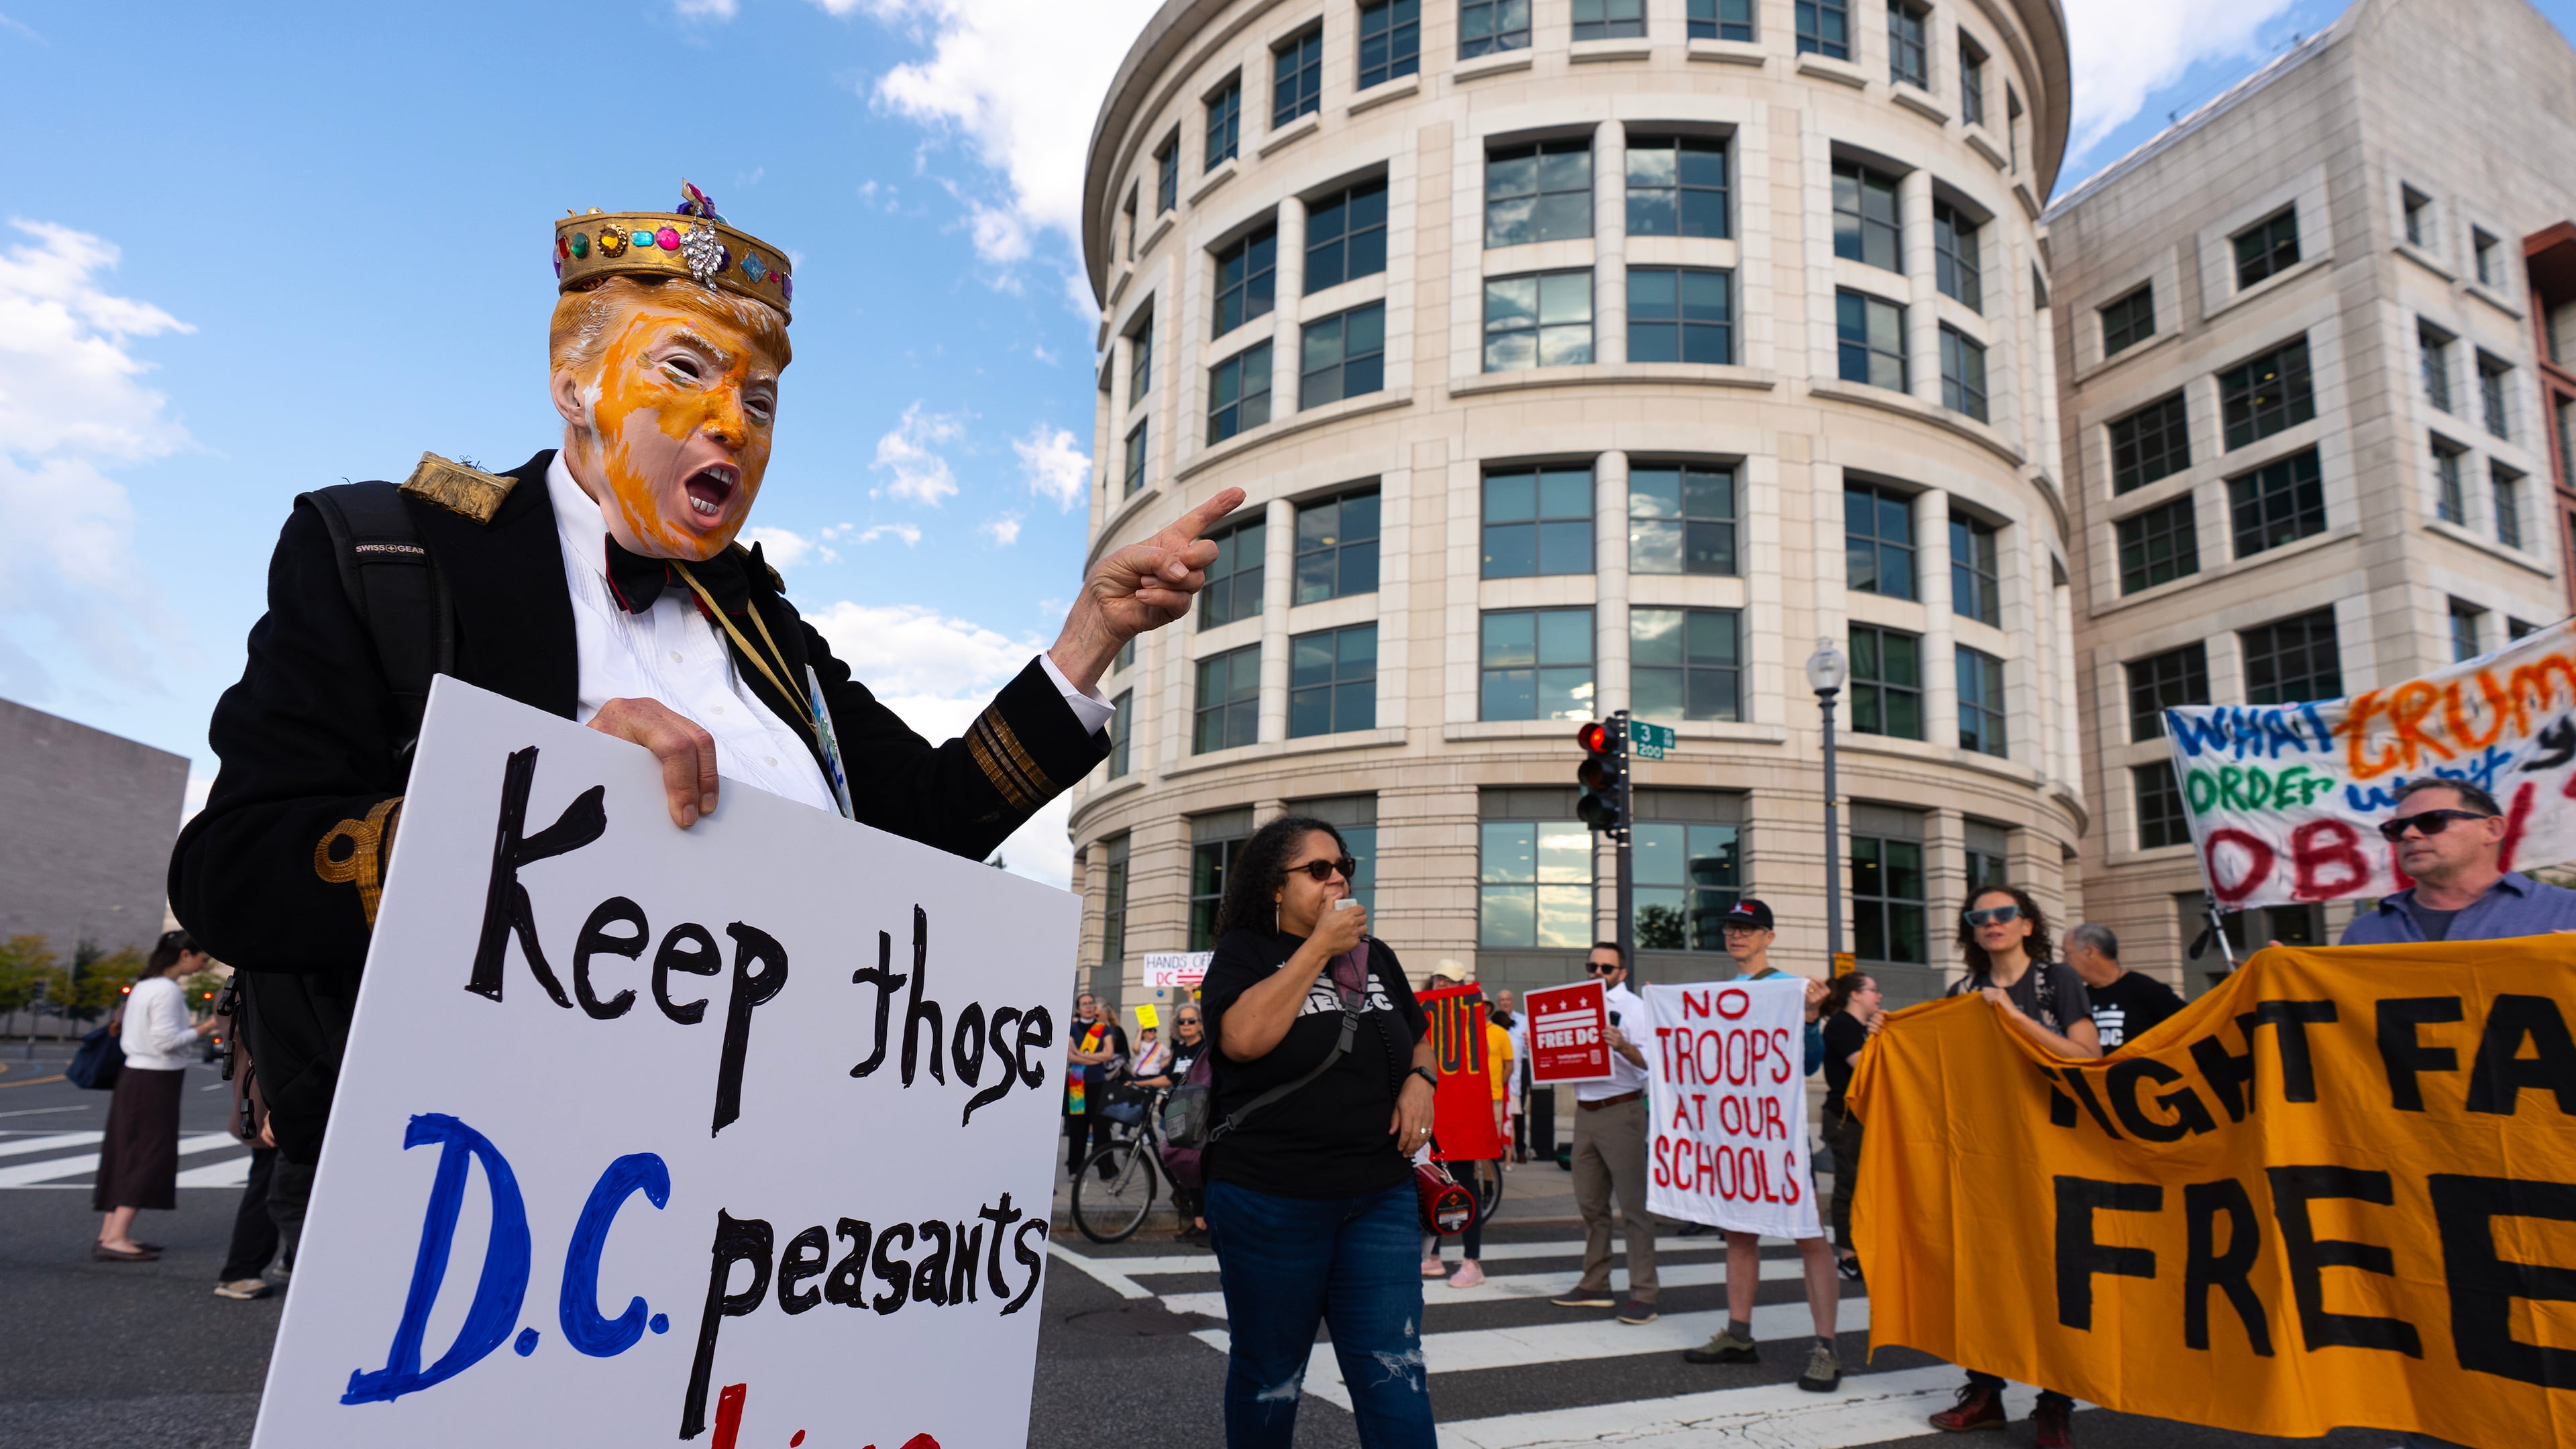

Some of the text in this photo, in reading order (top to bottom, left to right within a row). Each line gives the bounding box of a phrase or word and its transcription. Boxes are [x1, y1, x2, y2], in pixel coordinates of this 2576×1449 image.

[356, 544, 425, 555] SWISS GEAR
[1640, 724, 1651, 742] 3
[2167, 699, 2341, 760] WHAT
[1639, 743, 1662, 758] 200
[465, 745, 1054, 1138] Keep those
[1146, 955, 1187, 969] HANDS
[1156, 971, 1173, 986] DC
[1683, 988, 1750, 1020] NO
[1536, 1026, 1599, 1050] FREE DC
[1655, 1027, 1791, 1086] TROOPS
[1672, 1094, 1787, 1141] AT OUR
[1654, 1134, 1801, 1205] SCHOOLS
[340, 1112, 1049, 1442] D.C. peasants
[2053, 1165, 2576, 1391] FREE
